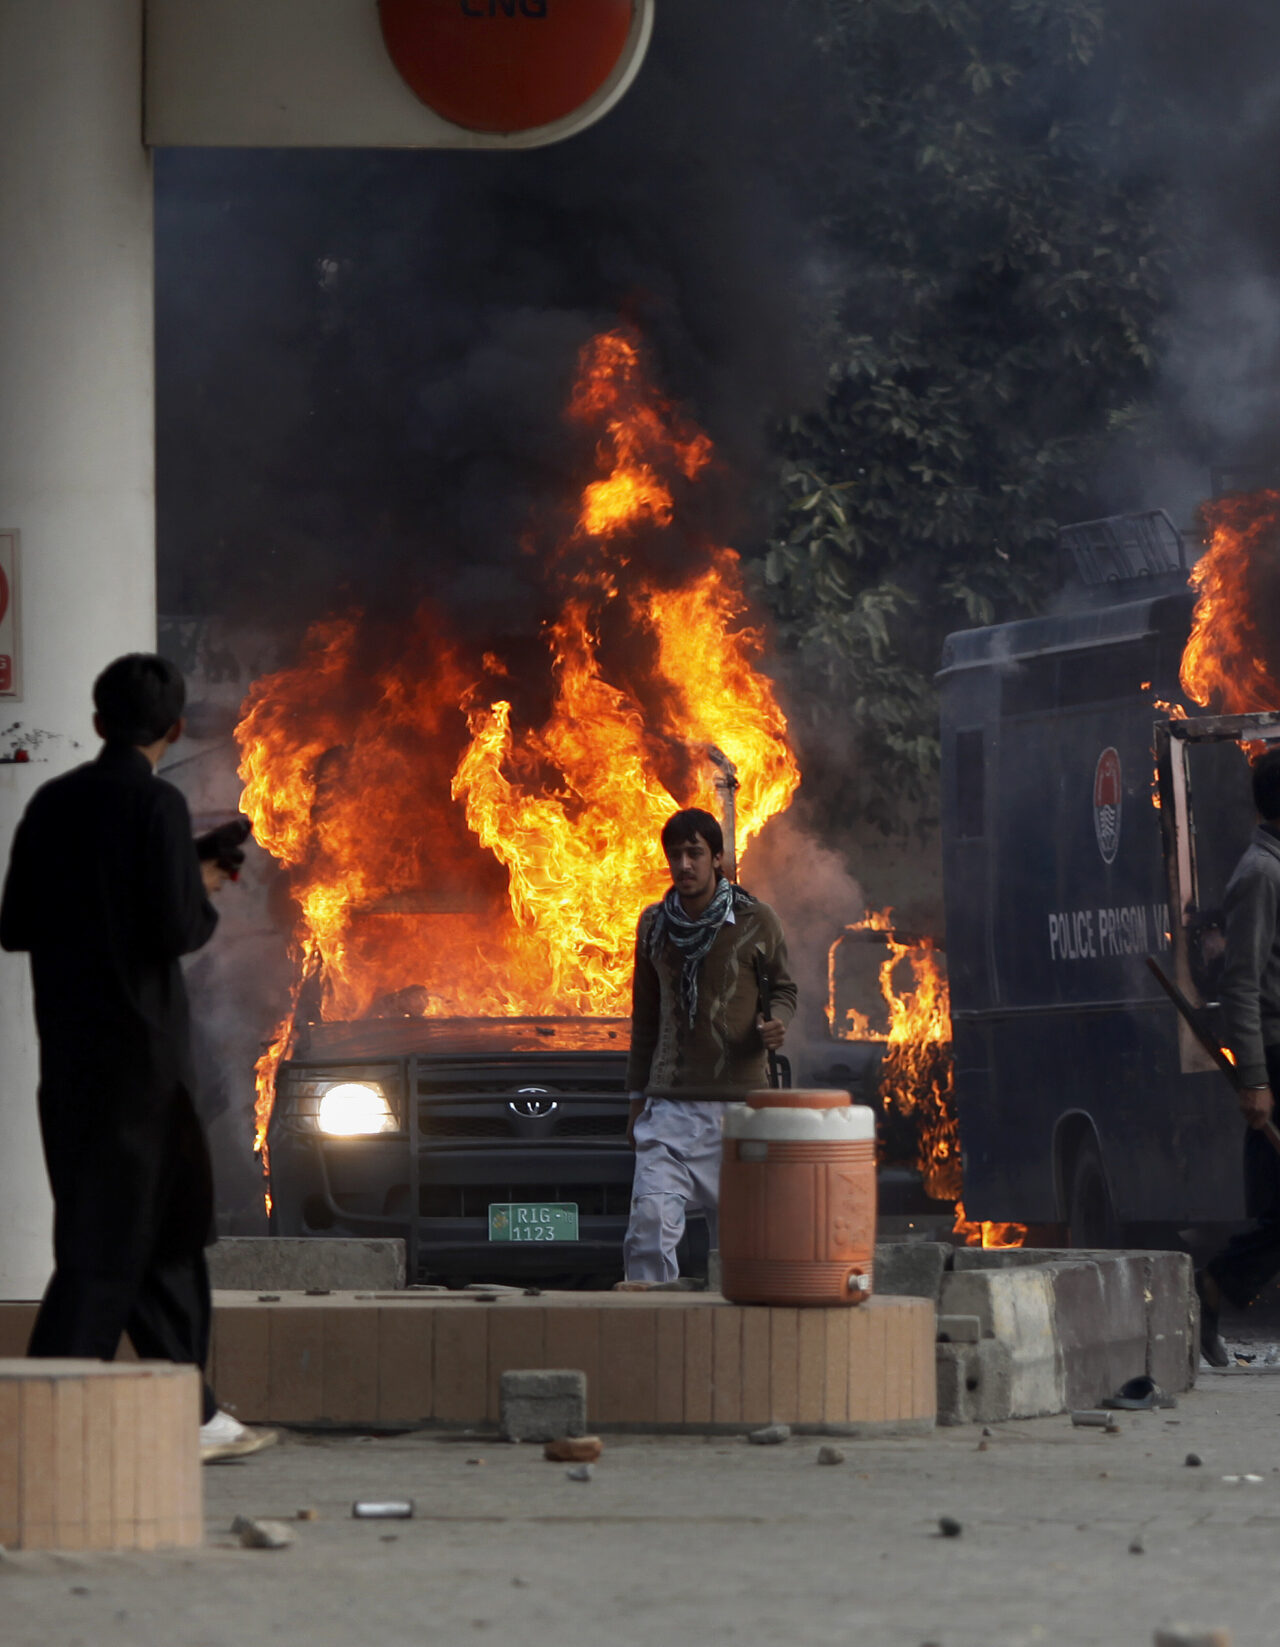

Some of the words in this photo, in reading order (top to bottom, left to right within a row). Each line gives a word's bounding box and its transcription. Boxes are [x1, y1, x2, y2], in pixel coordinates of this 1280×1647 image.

[460, 0, 547, 18] CNG
[1048, 910, 1097, 960] POLICE
[1098, 904, 1148, 956] PRISON
[512, 1225, 556, 1241] 1123
